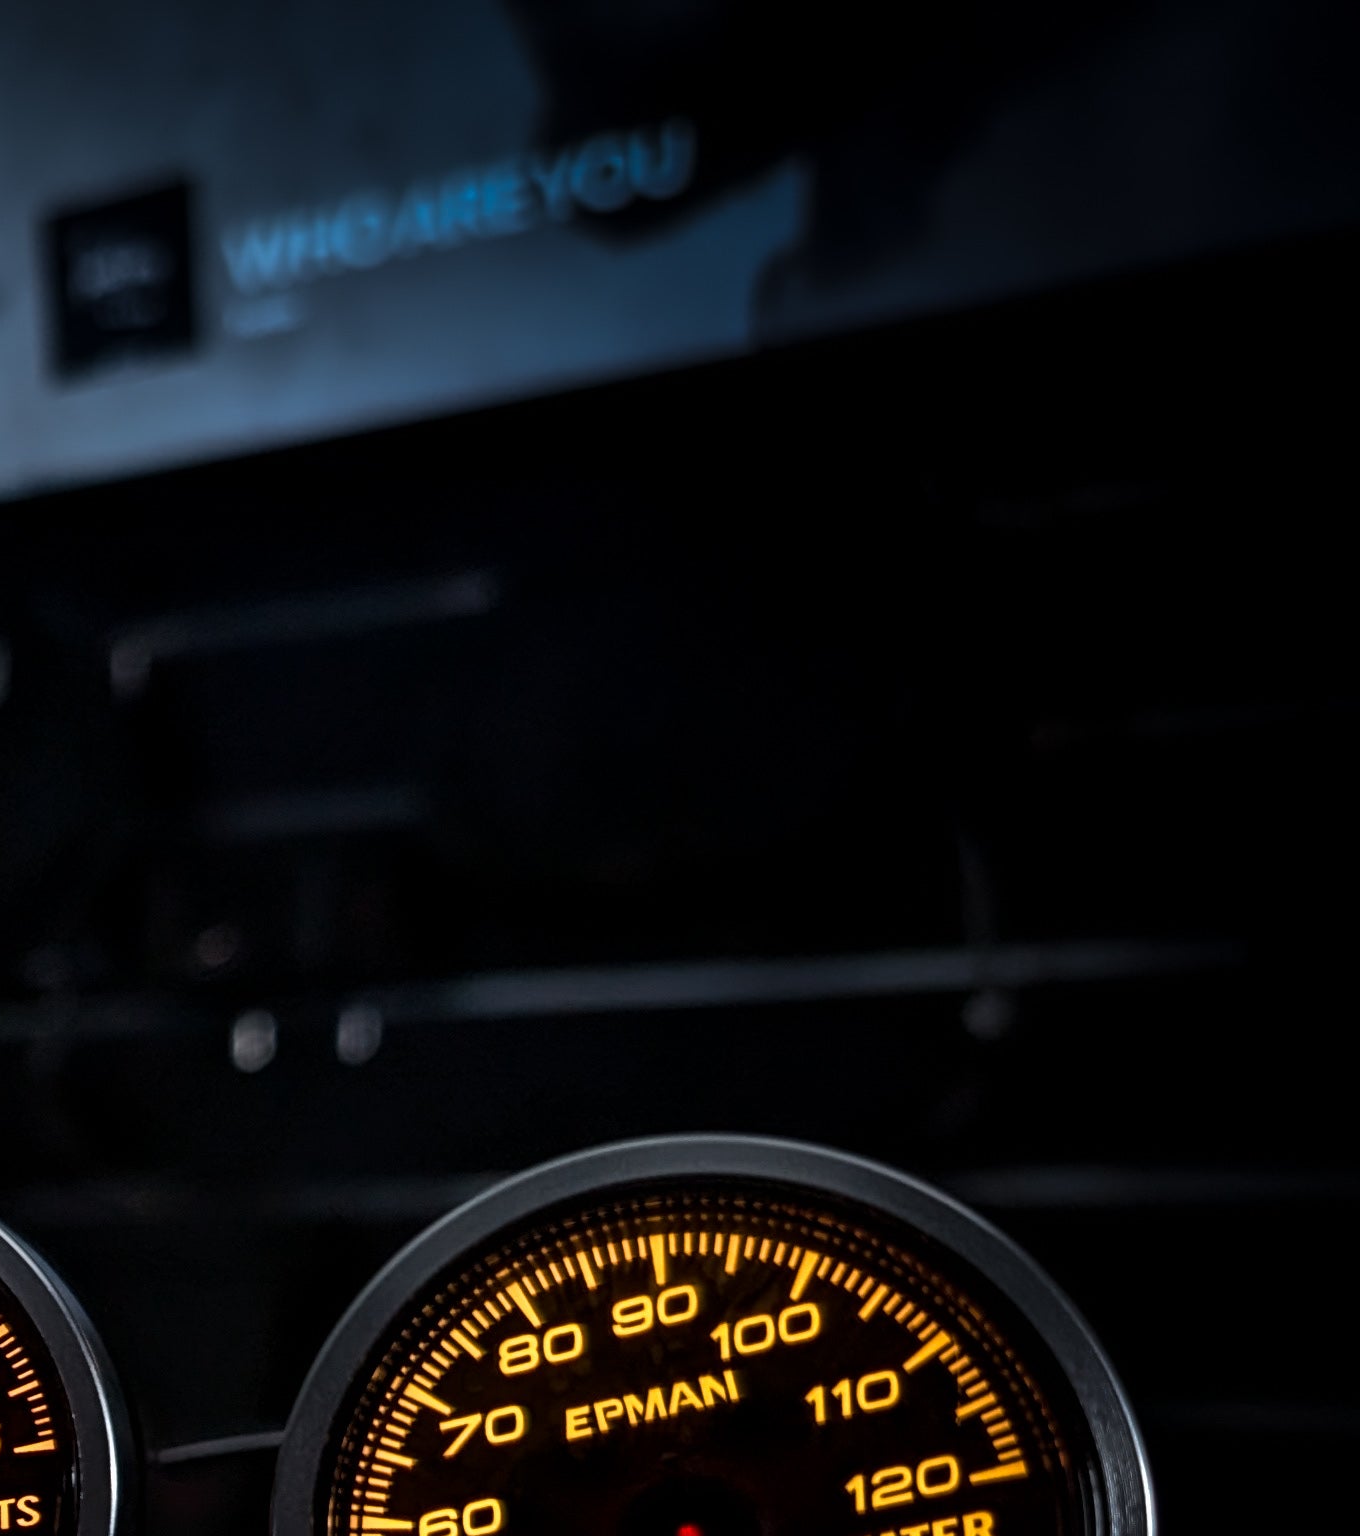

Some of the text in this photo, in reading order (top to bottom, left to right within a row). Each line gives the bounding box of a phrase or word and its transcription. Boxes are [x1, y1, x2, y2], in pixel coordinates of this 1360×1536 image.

[612, 1284, 698, 1337] 90
[710, 1302, 821, 1361] 100
[497, 1323, 583, 1375] 80
[565, 1369, 740, 1441] EPMAN
[804, 1370, 900, 1426] 110
[440, 1405, 526, 1457] 70
[844, 1455, 960, 1514] 120
